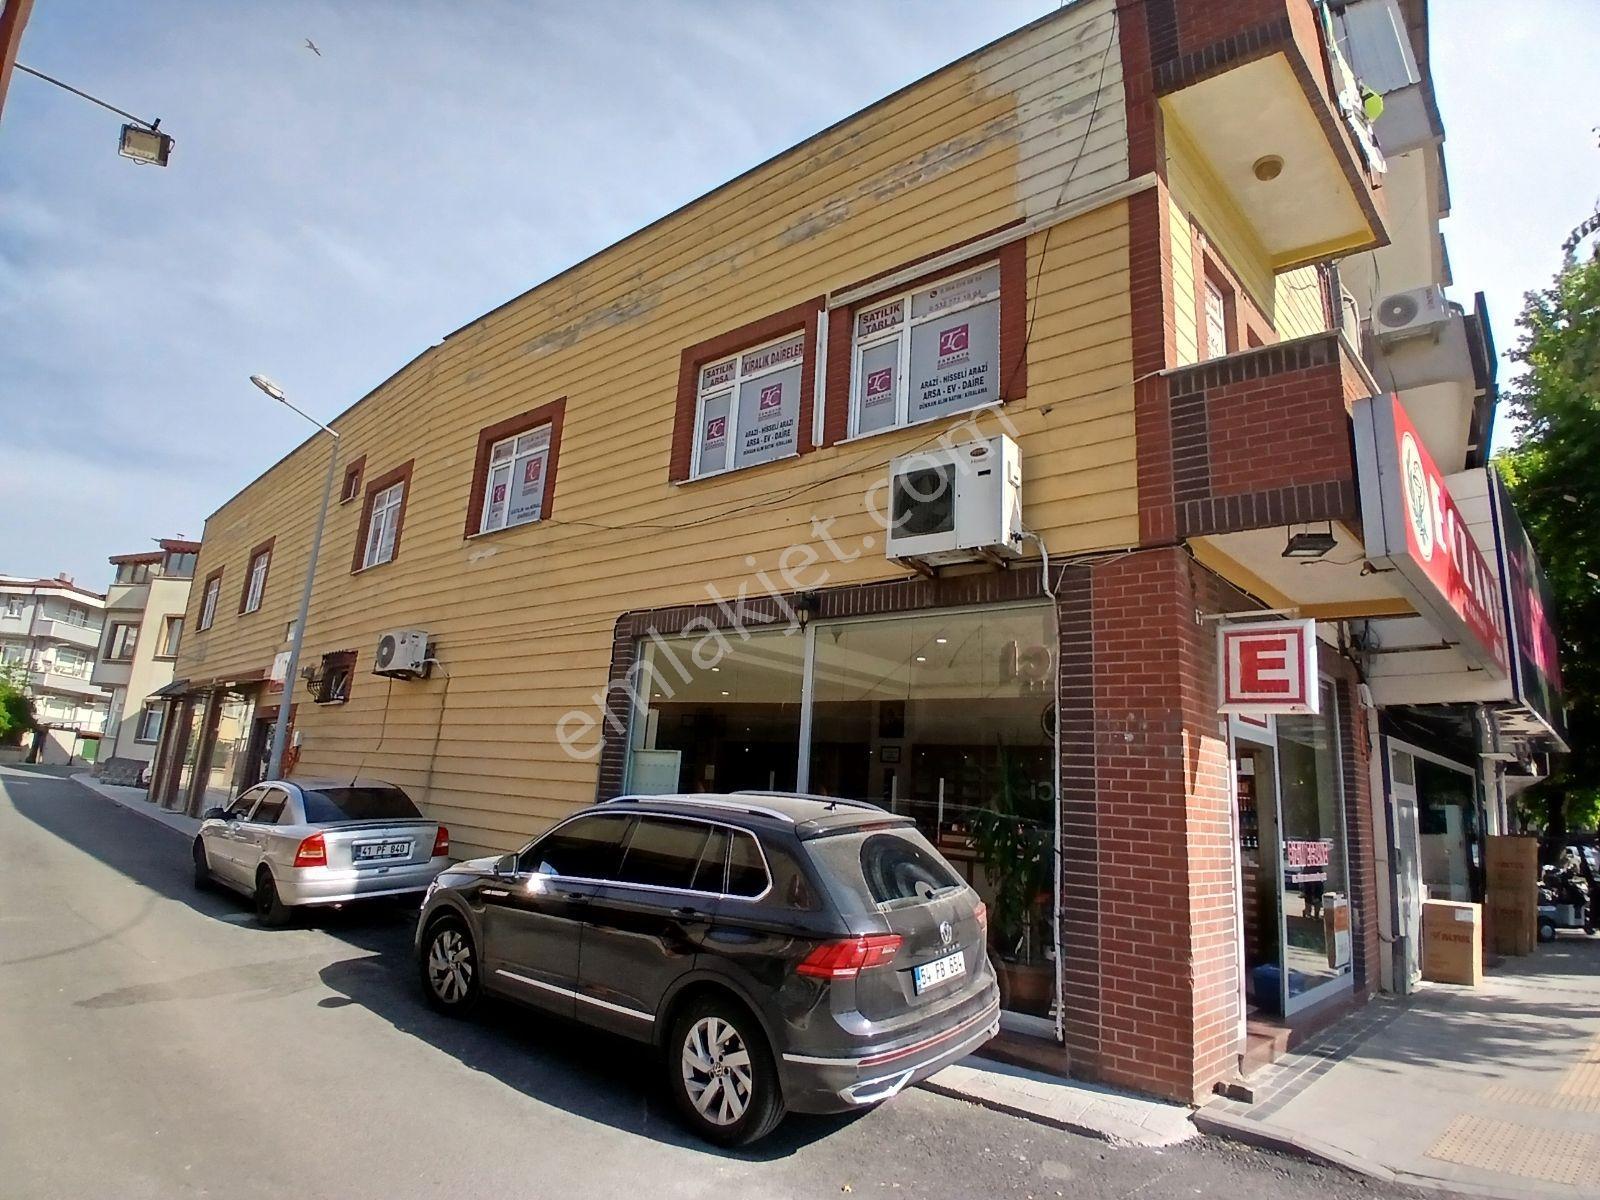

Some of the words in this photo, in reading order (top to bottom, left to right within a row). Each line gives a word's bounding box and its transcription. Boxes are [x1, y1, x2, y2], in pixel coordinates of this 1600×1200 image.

[863, 304, 900, 324] SATILIK
[866, 315, 896, 334] TARLA
[706, 363, 734, 379] SATILIK
[743, 356, 770, 373] KİRALIK
[710, 374, 729, 387] ARSA
[923, 388, 941, 400] ARSA
[947, 384, 957, 394] EV
[962, 376, 984, 390] DAİRE
[1239, 639, 1290, 694] E
[362, 846, 372, 856] 41
[376, 845, 387, 855] PF
[920, 968, 931, 985] 54
[935, 961, 946, 979] FB
